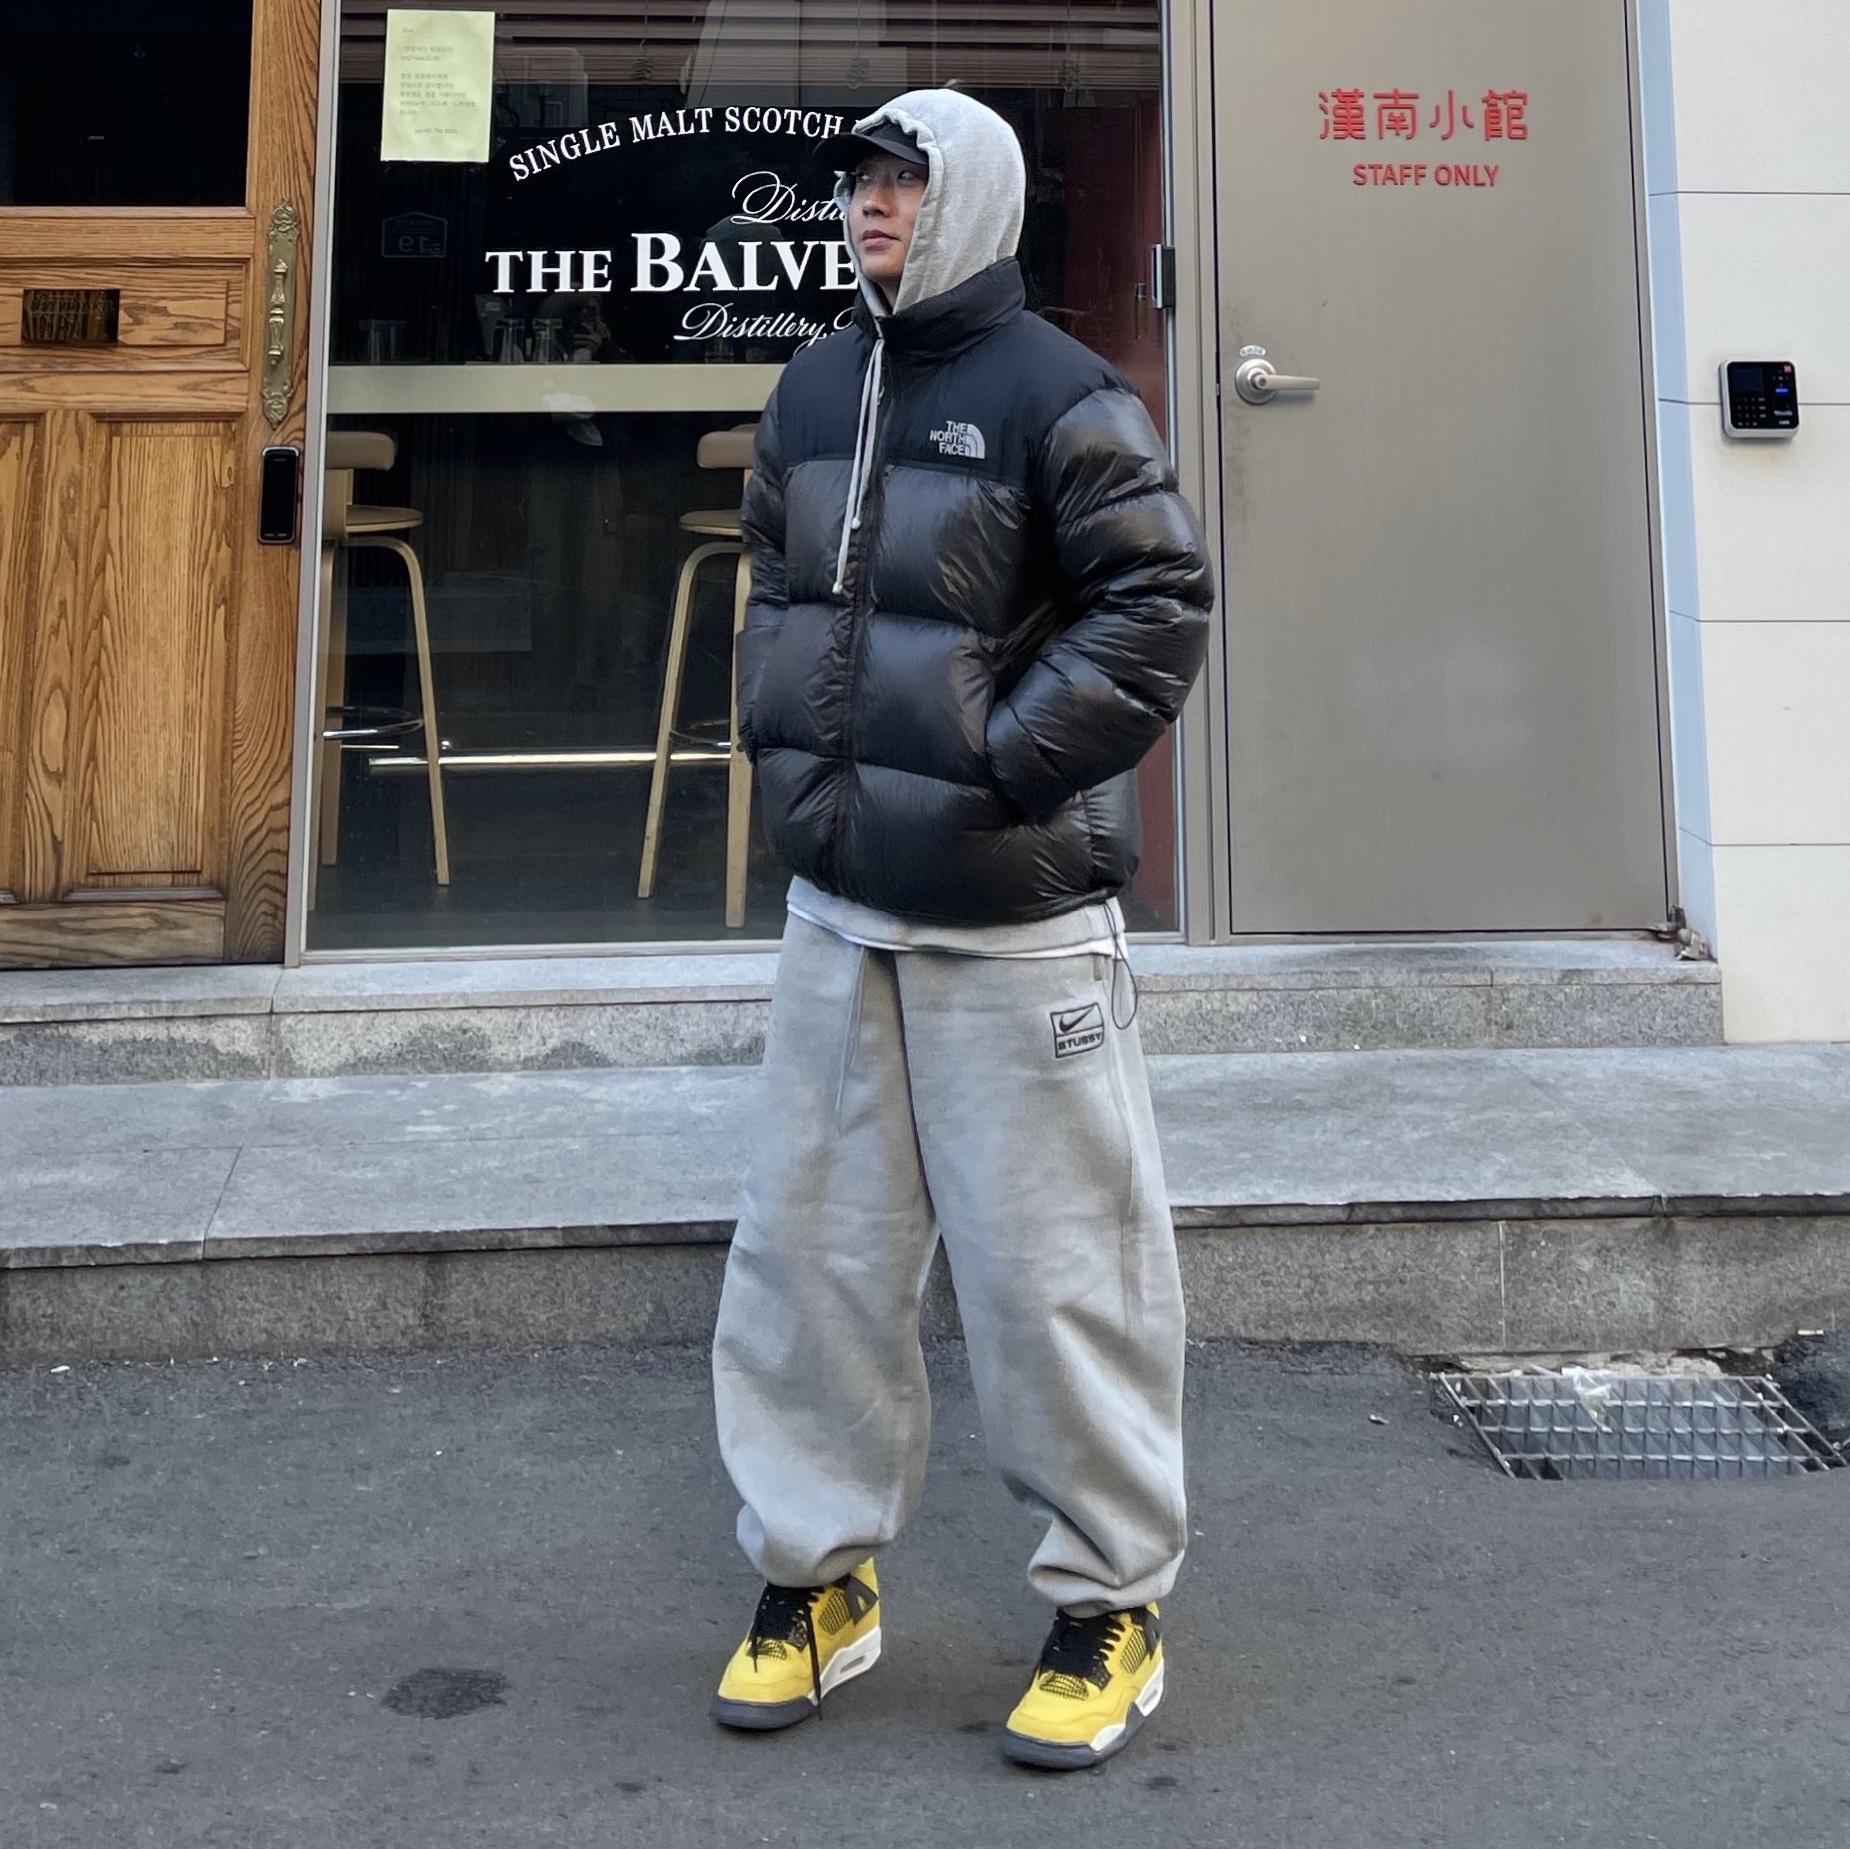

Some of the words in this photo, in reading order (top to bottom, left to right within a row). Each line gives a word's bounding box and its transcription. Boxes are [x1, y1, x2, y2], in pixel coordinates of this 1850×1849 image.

[1318, 87, 1530, 141] 漢南小館
[509, 121, 621, 182] SINGLE
[628, 107, 713, 144] MALT
[725, 106, 844, 140] SCOTCH
[1352, 162, 1427, 187] STAFF
[1433, 163, 1499, 187] ONLY
[484, 250, 613, 293] THE
[929, 429, 967, 445] NORTH
[946, 420, 967, 434] THE
[938, 442, 966, 456] FACE
